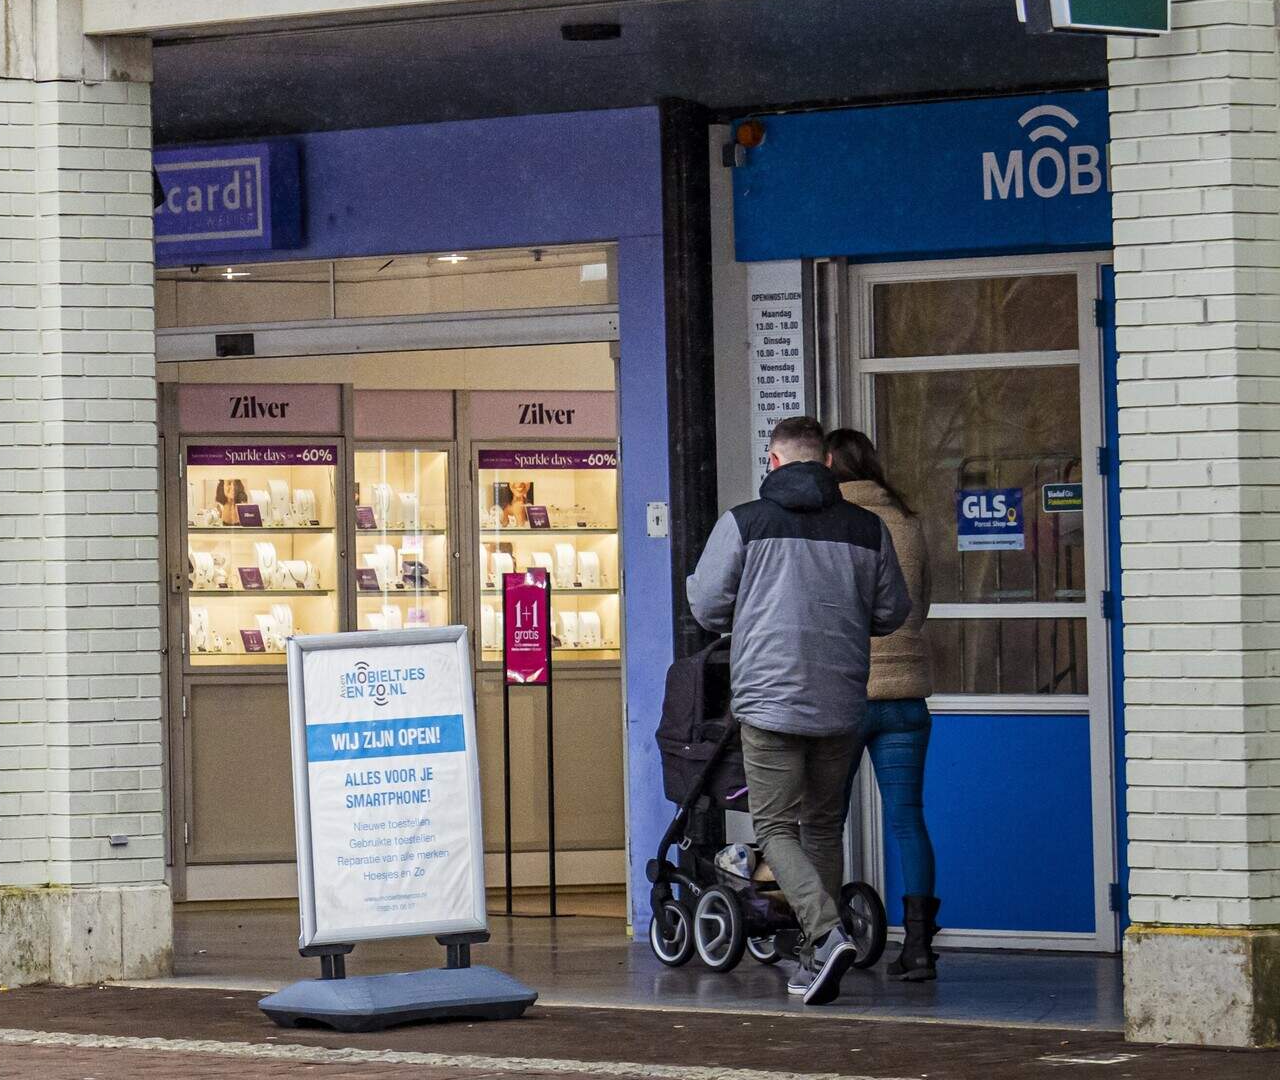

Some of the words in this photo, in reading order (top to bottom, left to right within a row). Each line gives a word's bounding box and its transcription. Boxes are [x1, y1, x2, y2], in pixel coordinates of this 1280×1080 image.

[761, 310, 792, 318] Maandag
[763, 336, 791, 345] Dinsdag
[759, 363, 795, 372] Woensdag
[759, 391, 797, 399] Donderdag
[229, 395, 290, 419] Zilver
[518, 402, 576, 425] Zilver
[224, 448, 262, 464] Sparkle
[263, 448, 286, 464] days
[296, 448, 333, 461] -60%
[514, 453, 550, 468] Sparkle
[551, 453, 573, 468] days
[582, 453, 617, 466] -60%
[962, 495, 1007, 519] GLS
[515, 600, 539, 628] 1+1
[514, 627, 539, 643] gratis
[345, 668, 426, 685] MOBIELTJES
[347, 686, 364, 698] EN
[331, 732, 359, 751] WIJ
[362, 730, 394, 749] ZIJN
[398, 726, 441, 746] OPEN!
[345, 771, 381, 787] ALLES
[384, 768, 416, 784] VOOR
[420, 767, 433, 781] JE
[346, 788, 431, 808] SMARTPHONE!
[353, 821, 386, 831] Nieuwe
[388, 818, 431, 829] toestellen
[349, 838, 392, 849] Gebruikte
[394, 834, 436, 845] toestellen
[337, 856, 380, 869] Reparatie
[382, 854, 397, 863] van
[400, 851, 415, 862] alle
[417, 850, 449, 860] merken
[363, 871, 399, 882] Hoesjes
[400, 870, 411, 878] en
[414, 866, 426, 878] Zo
